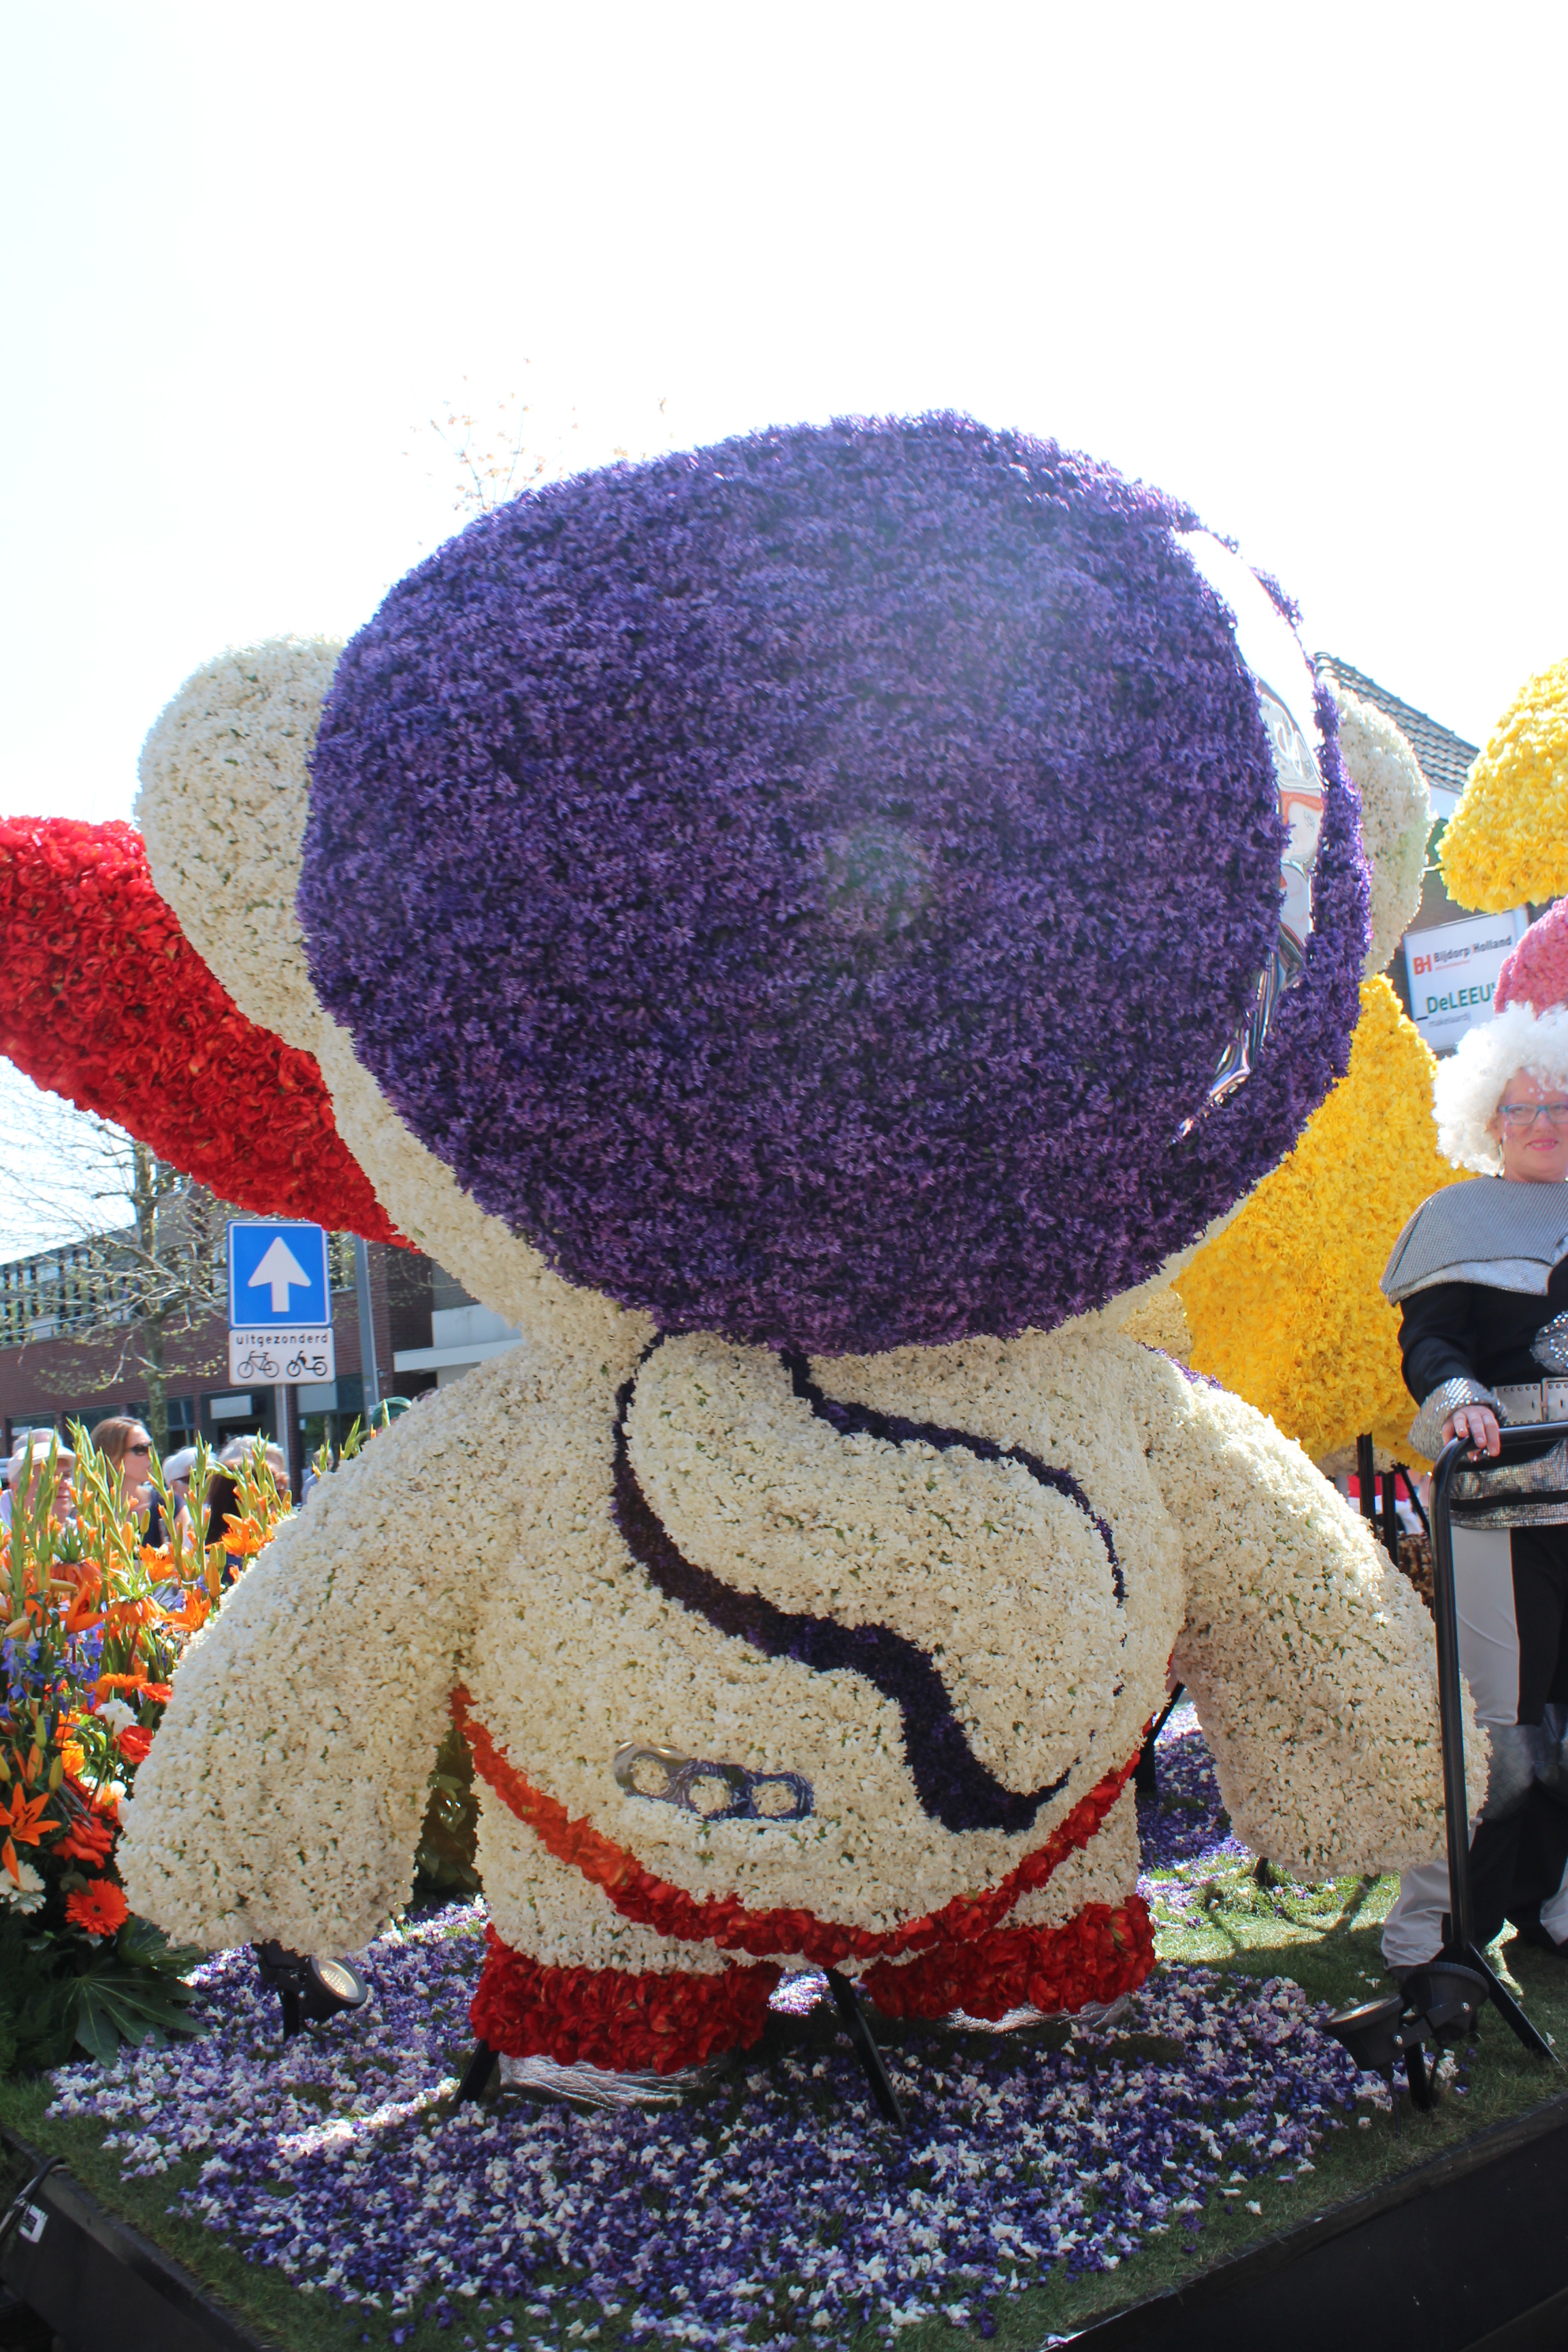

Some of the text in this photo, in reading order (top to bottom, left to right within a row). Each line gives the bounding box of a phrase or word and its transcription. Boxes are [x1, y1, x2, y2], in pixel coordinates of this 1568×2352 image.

[1472, 936, 1511, 953] Holland
[1426, 982, 1494, 1014] DeLEEU
[236, 1334, 327, 1347] uitgezonderd
